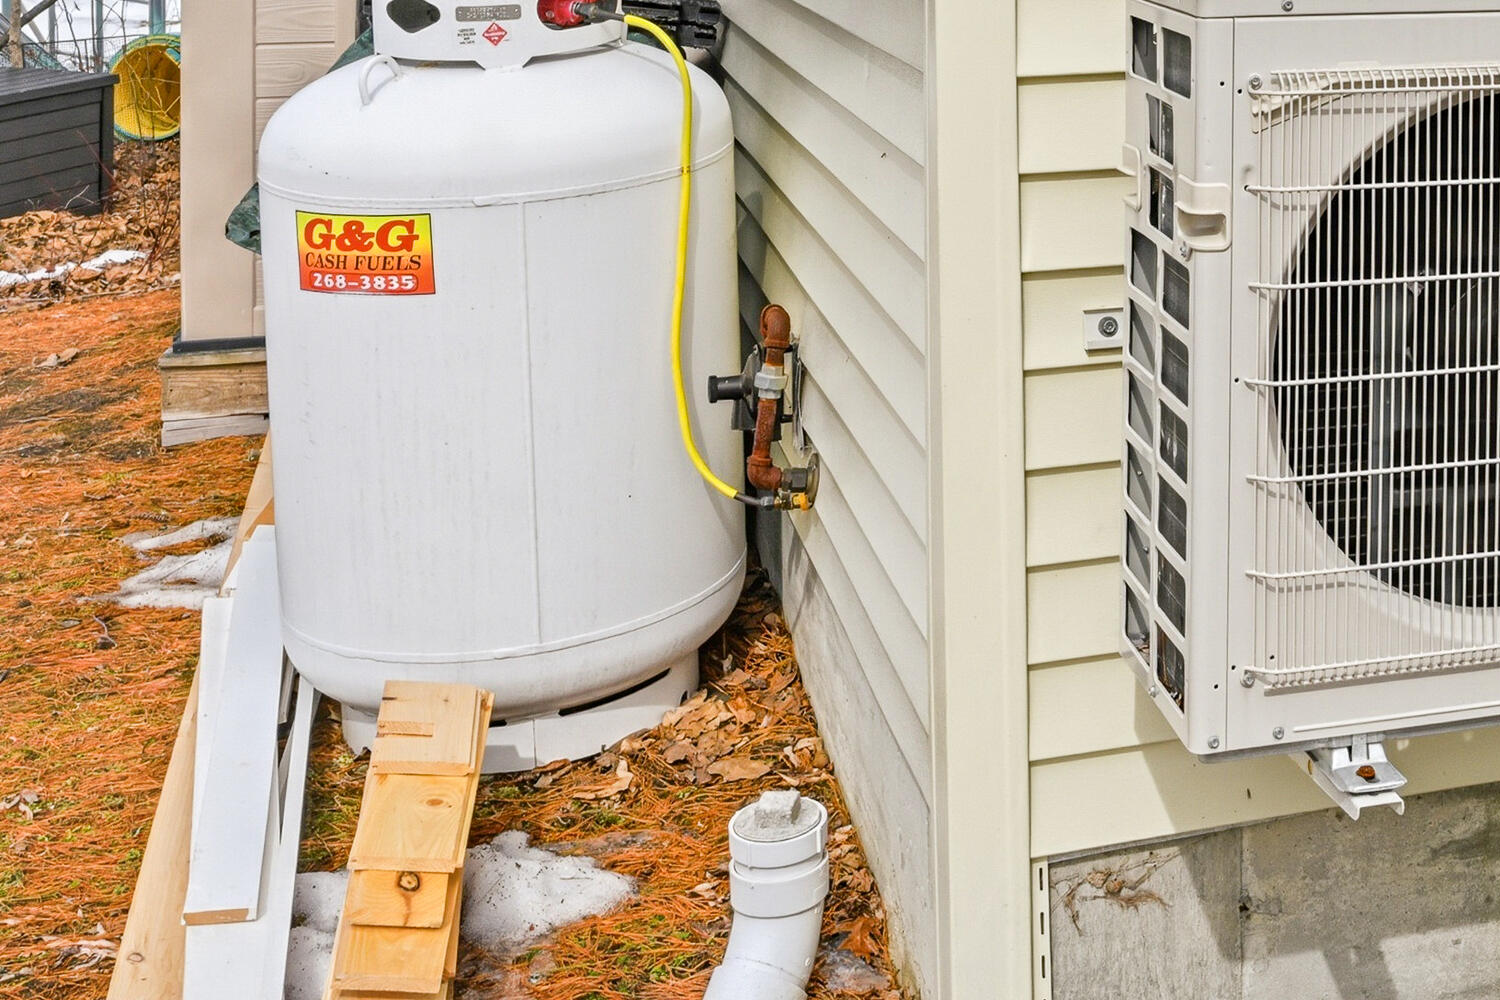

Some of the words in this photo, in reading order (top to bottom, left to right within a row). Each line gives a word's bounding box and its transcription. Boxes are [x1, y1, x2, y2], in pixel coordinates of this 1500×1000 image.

[304, 218, 420, 252] G&G
[305, 252, 348, 270] CASH
[354, 254, 422, 271] FUELS
[312, 272, 416, 290] 268-3835
